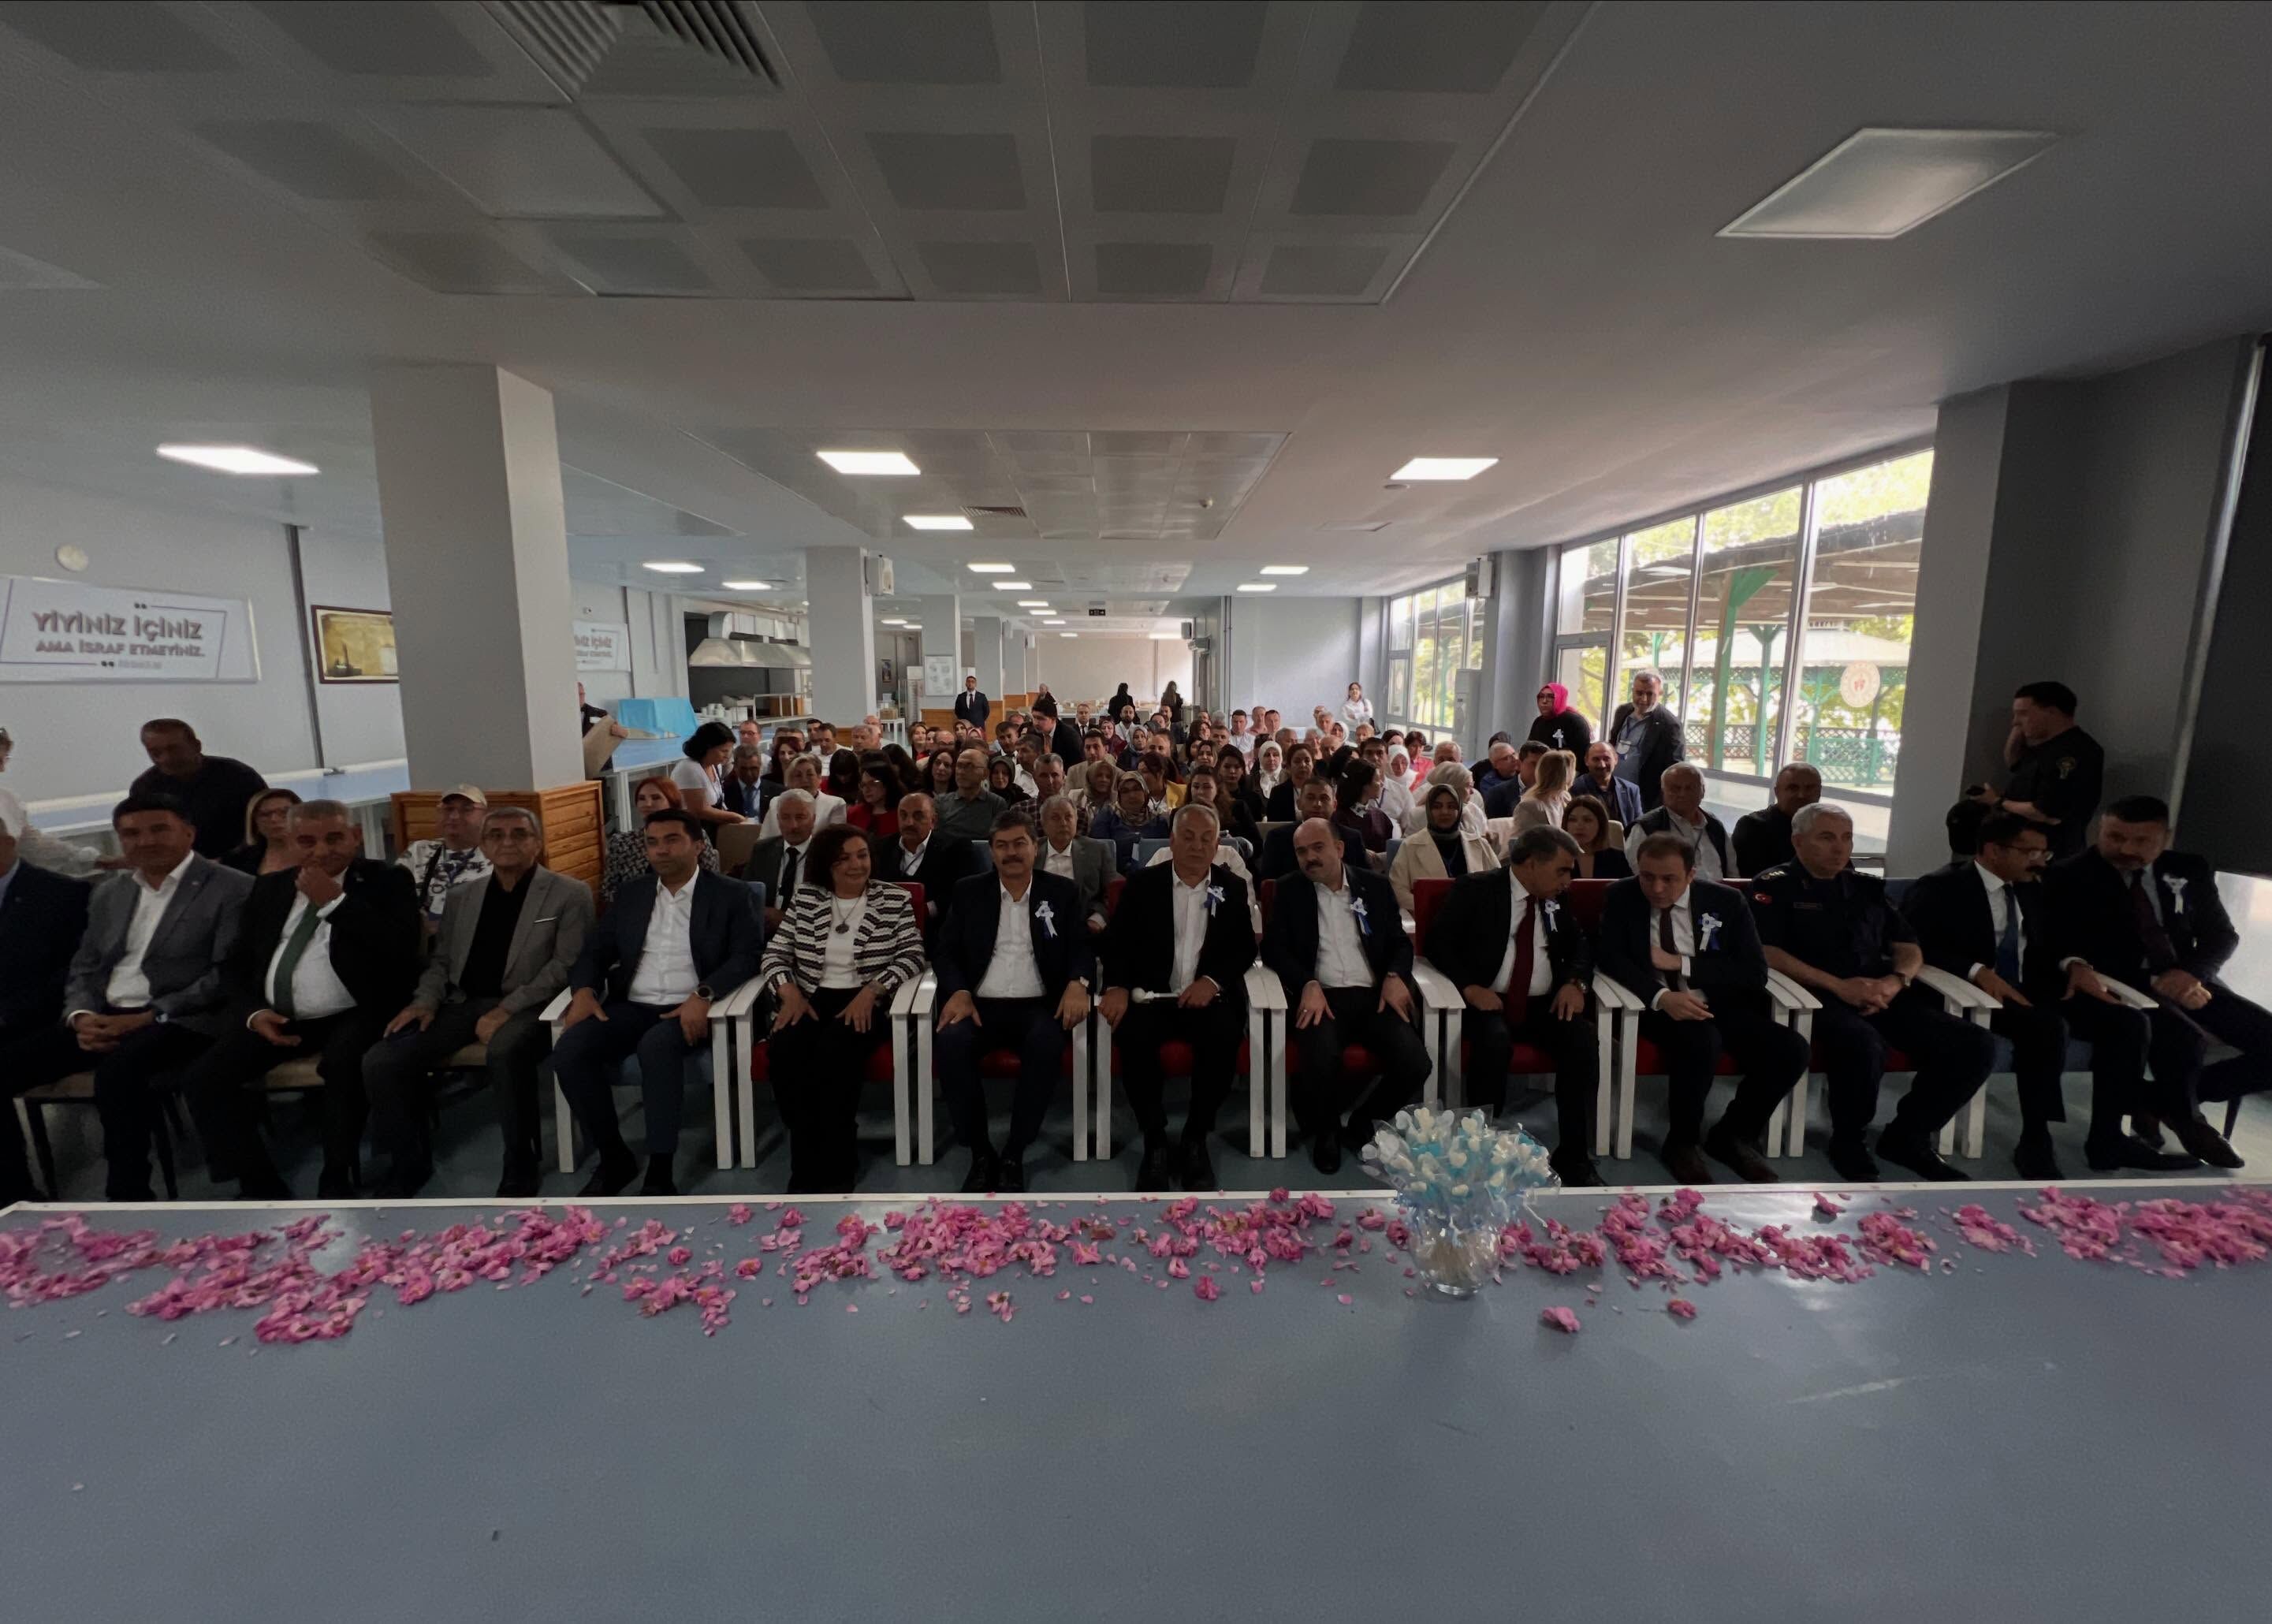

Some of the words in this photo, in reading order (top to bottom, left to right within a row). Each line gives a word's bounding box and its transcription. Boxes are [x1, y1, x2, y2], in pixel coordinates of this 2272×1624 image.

[32, 610, 126, 635] YİYİNİZ
[134, 615, 203, 642] İÇİNİZ
[35, 640, 74, 653] AMA
[80, 639, 125, 654] İSRAF
